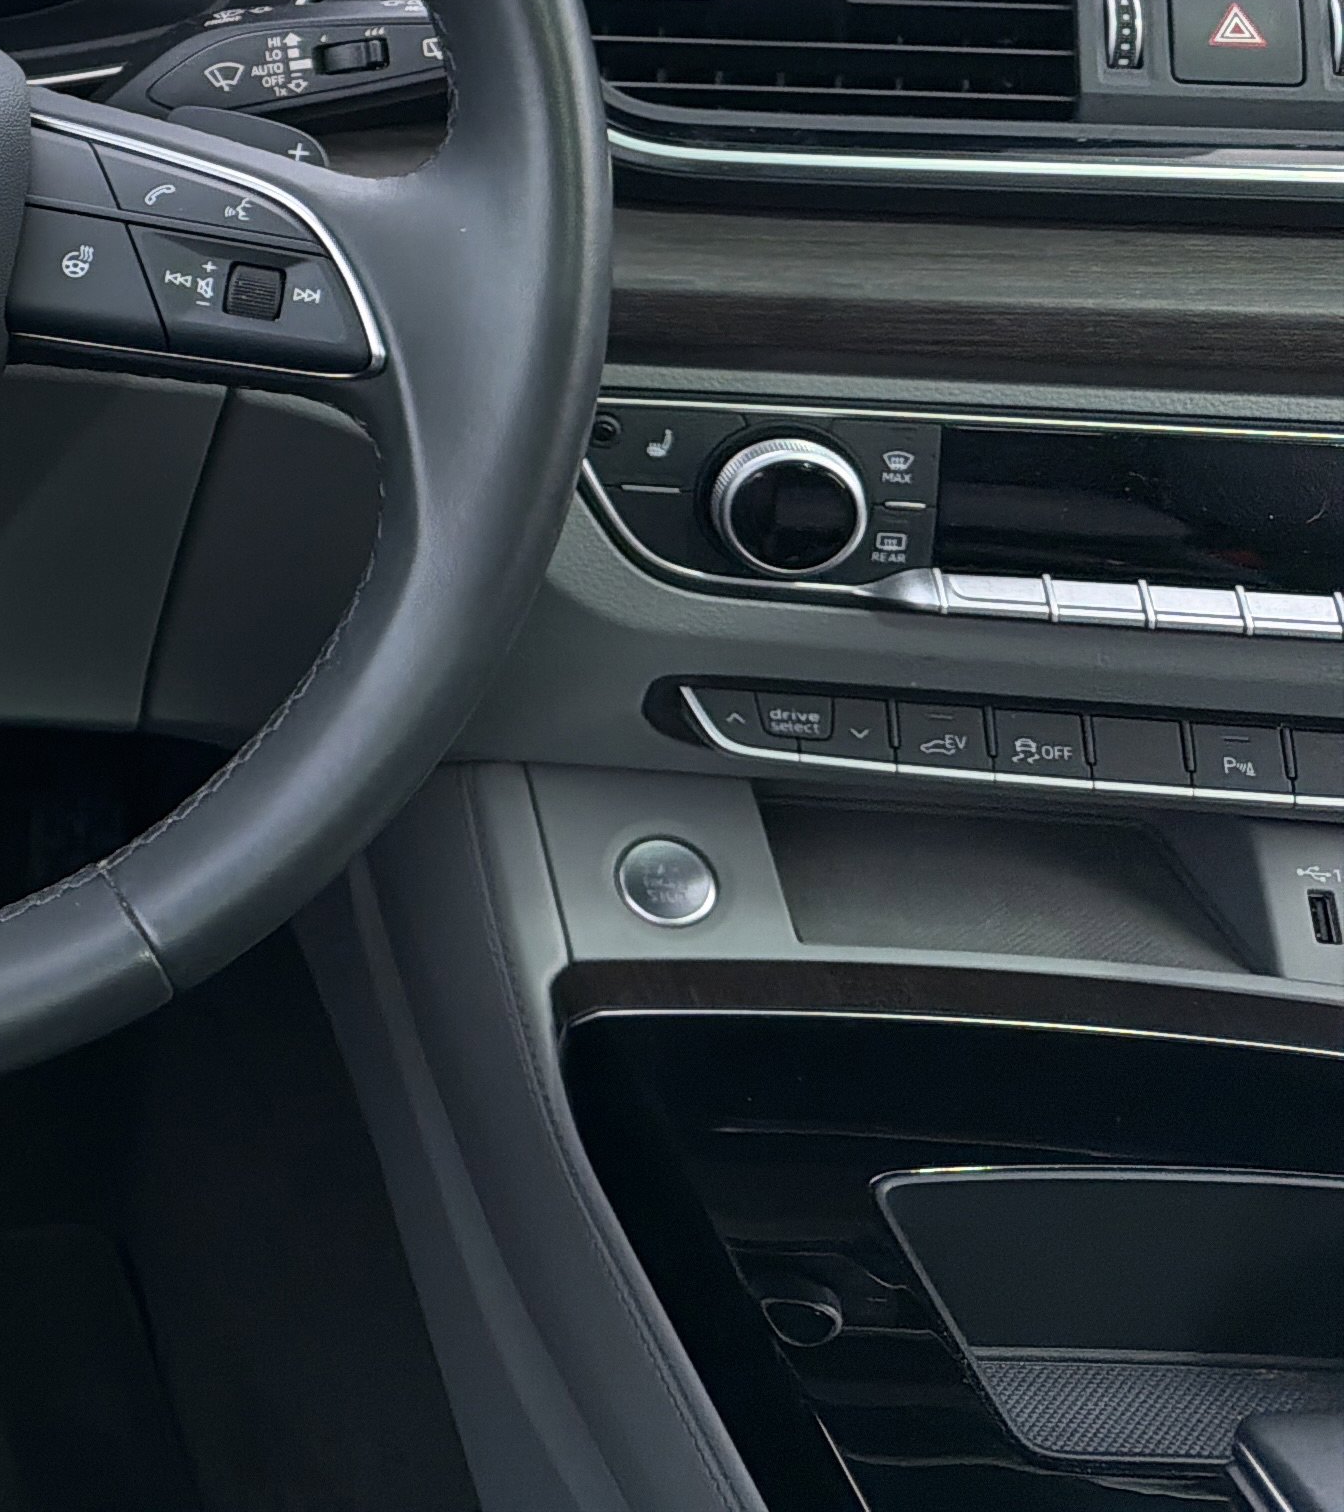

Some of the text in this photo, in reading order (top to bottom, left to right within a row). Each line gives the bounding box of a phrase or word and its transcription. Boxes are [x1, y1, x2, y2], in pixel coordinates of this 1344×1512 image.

[267, 37, 281, 48] HI
[265, 49, 282, 61] LO
[251, 63, 284, 77] AUTO
[262, 75, 285, 88] OFF
[881, 472, 913, 484] MAX
[870, 551, 906, 563] REAR
[769, 709, 821, 723] drive
[770, 720, 821, 735] select
[945, 734, 967, 750] EV
[1041, 744, 1073, 761] OFF
